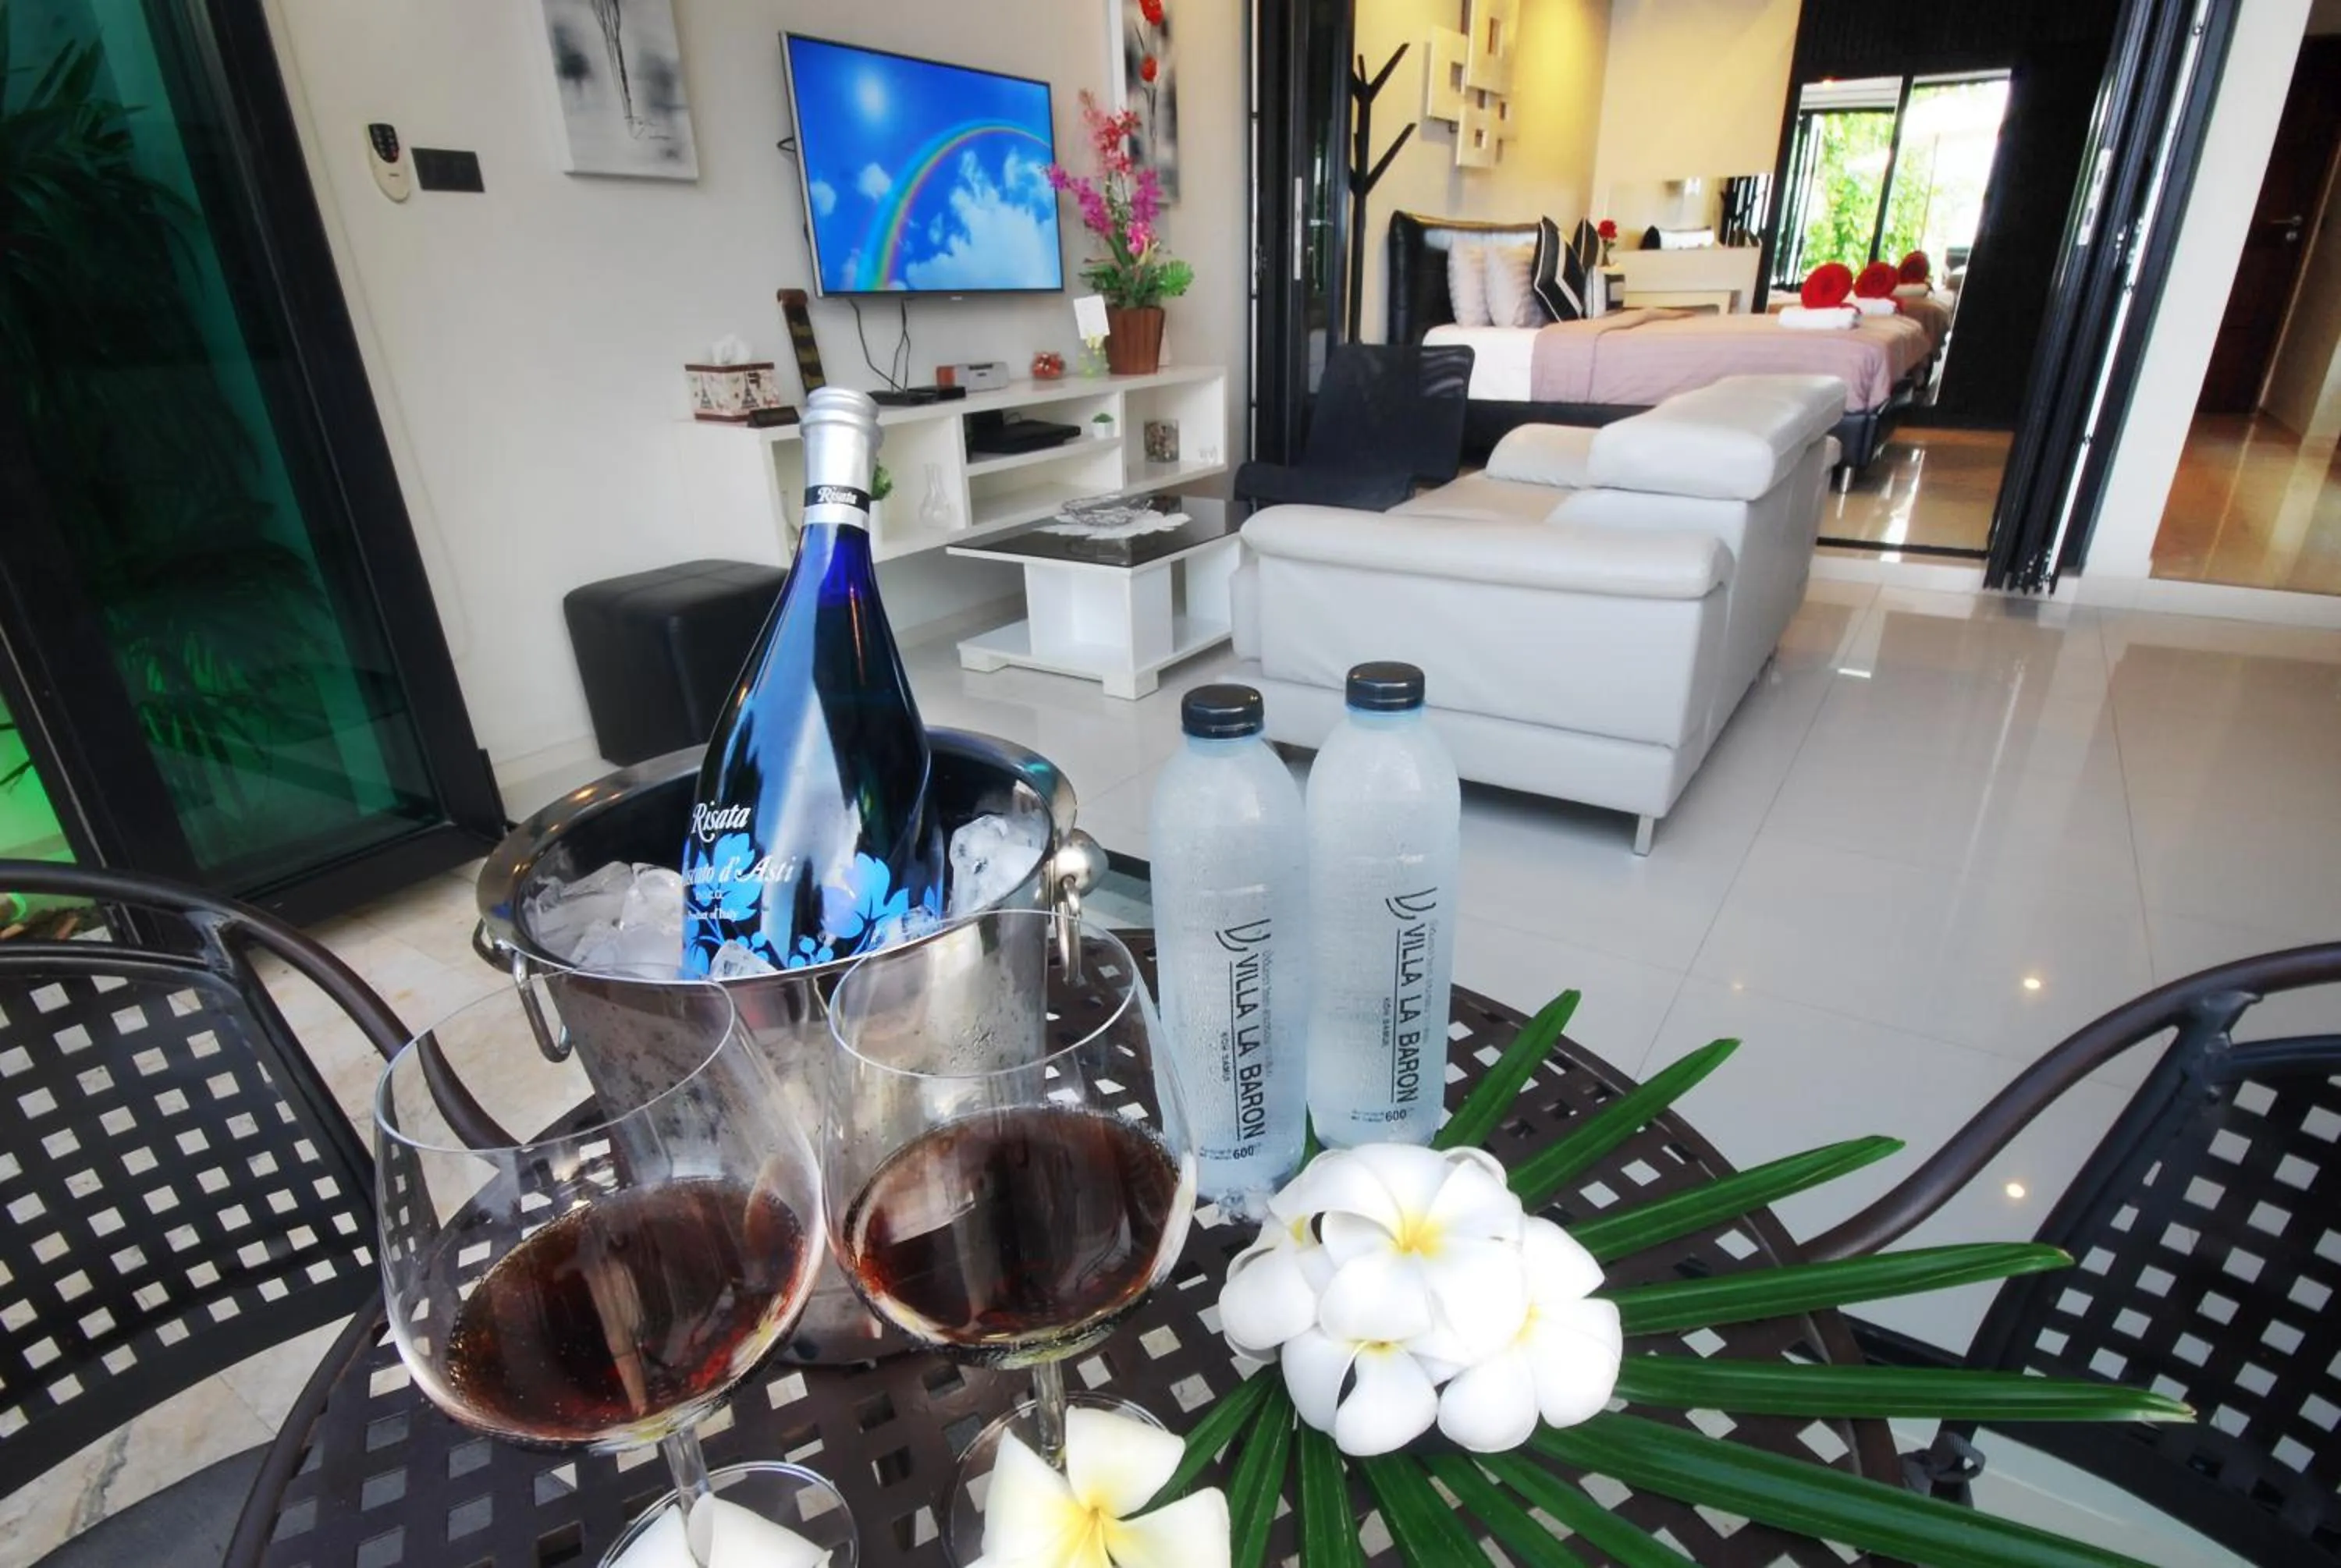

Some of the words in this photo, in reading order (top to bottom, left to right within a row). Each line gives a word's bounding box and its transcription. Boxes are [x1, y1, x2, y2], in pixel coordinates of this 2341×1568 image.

[817, 486, 858, 505] Risata
[691, 800, 751, 843] Risata
[1401, 922, 1426, 987] VILLA
[1235, 952, 1259, 1020] VILLA
[1399, 994, 1423, 1024] LA
[1237, 1024, 1260, 1058] LA
[1396, 1031, 1421, 1104] BARON
[1239, 1062, 1266, 1140] BARON
[1385, 1109, 1407, 1123] 600
[1232, 1144, 1254, 1160] 600
